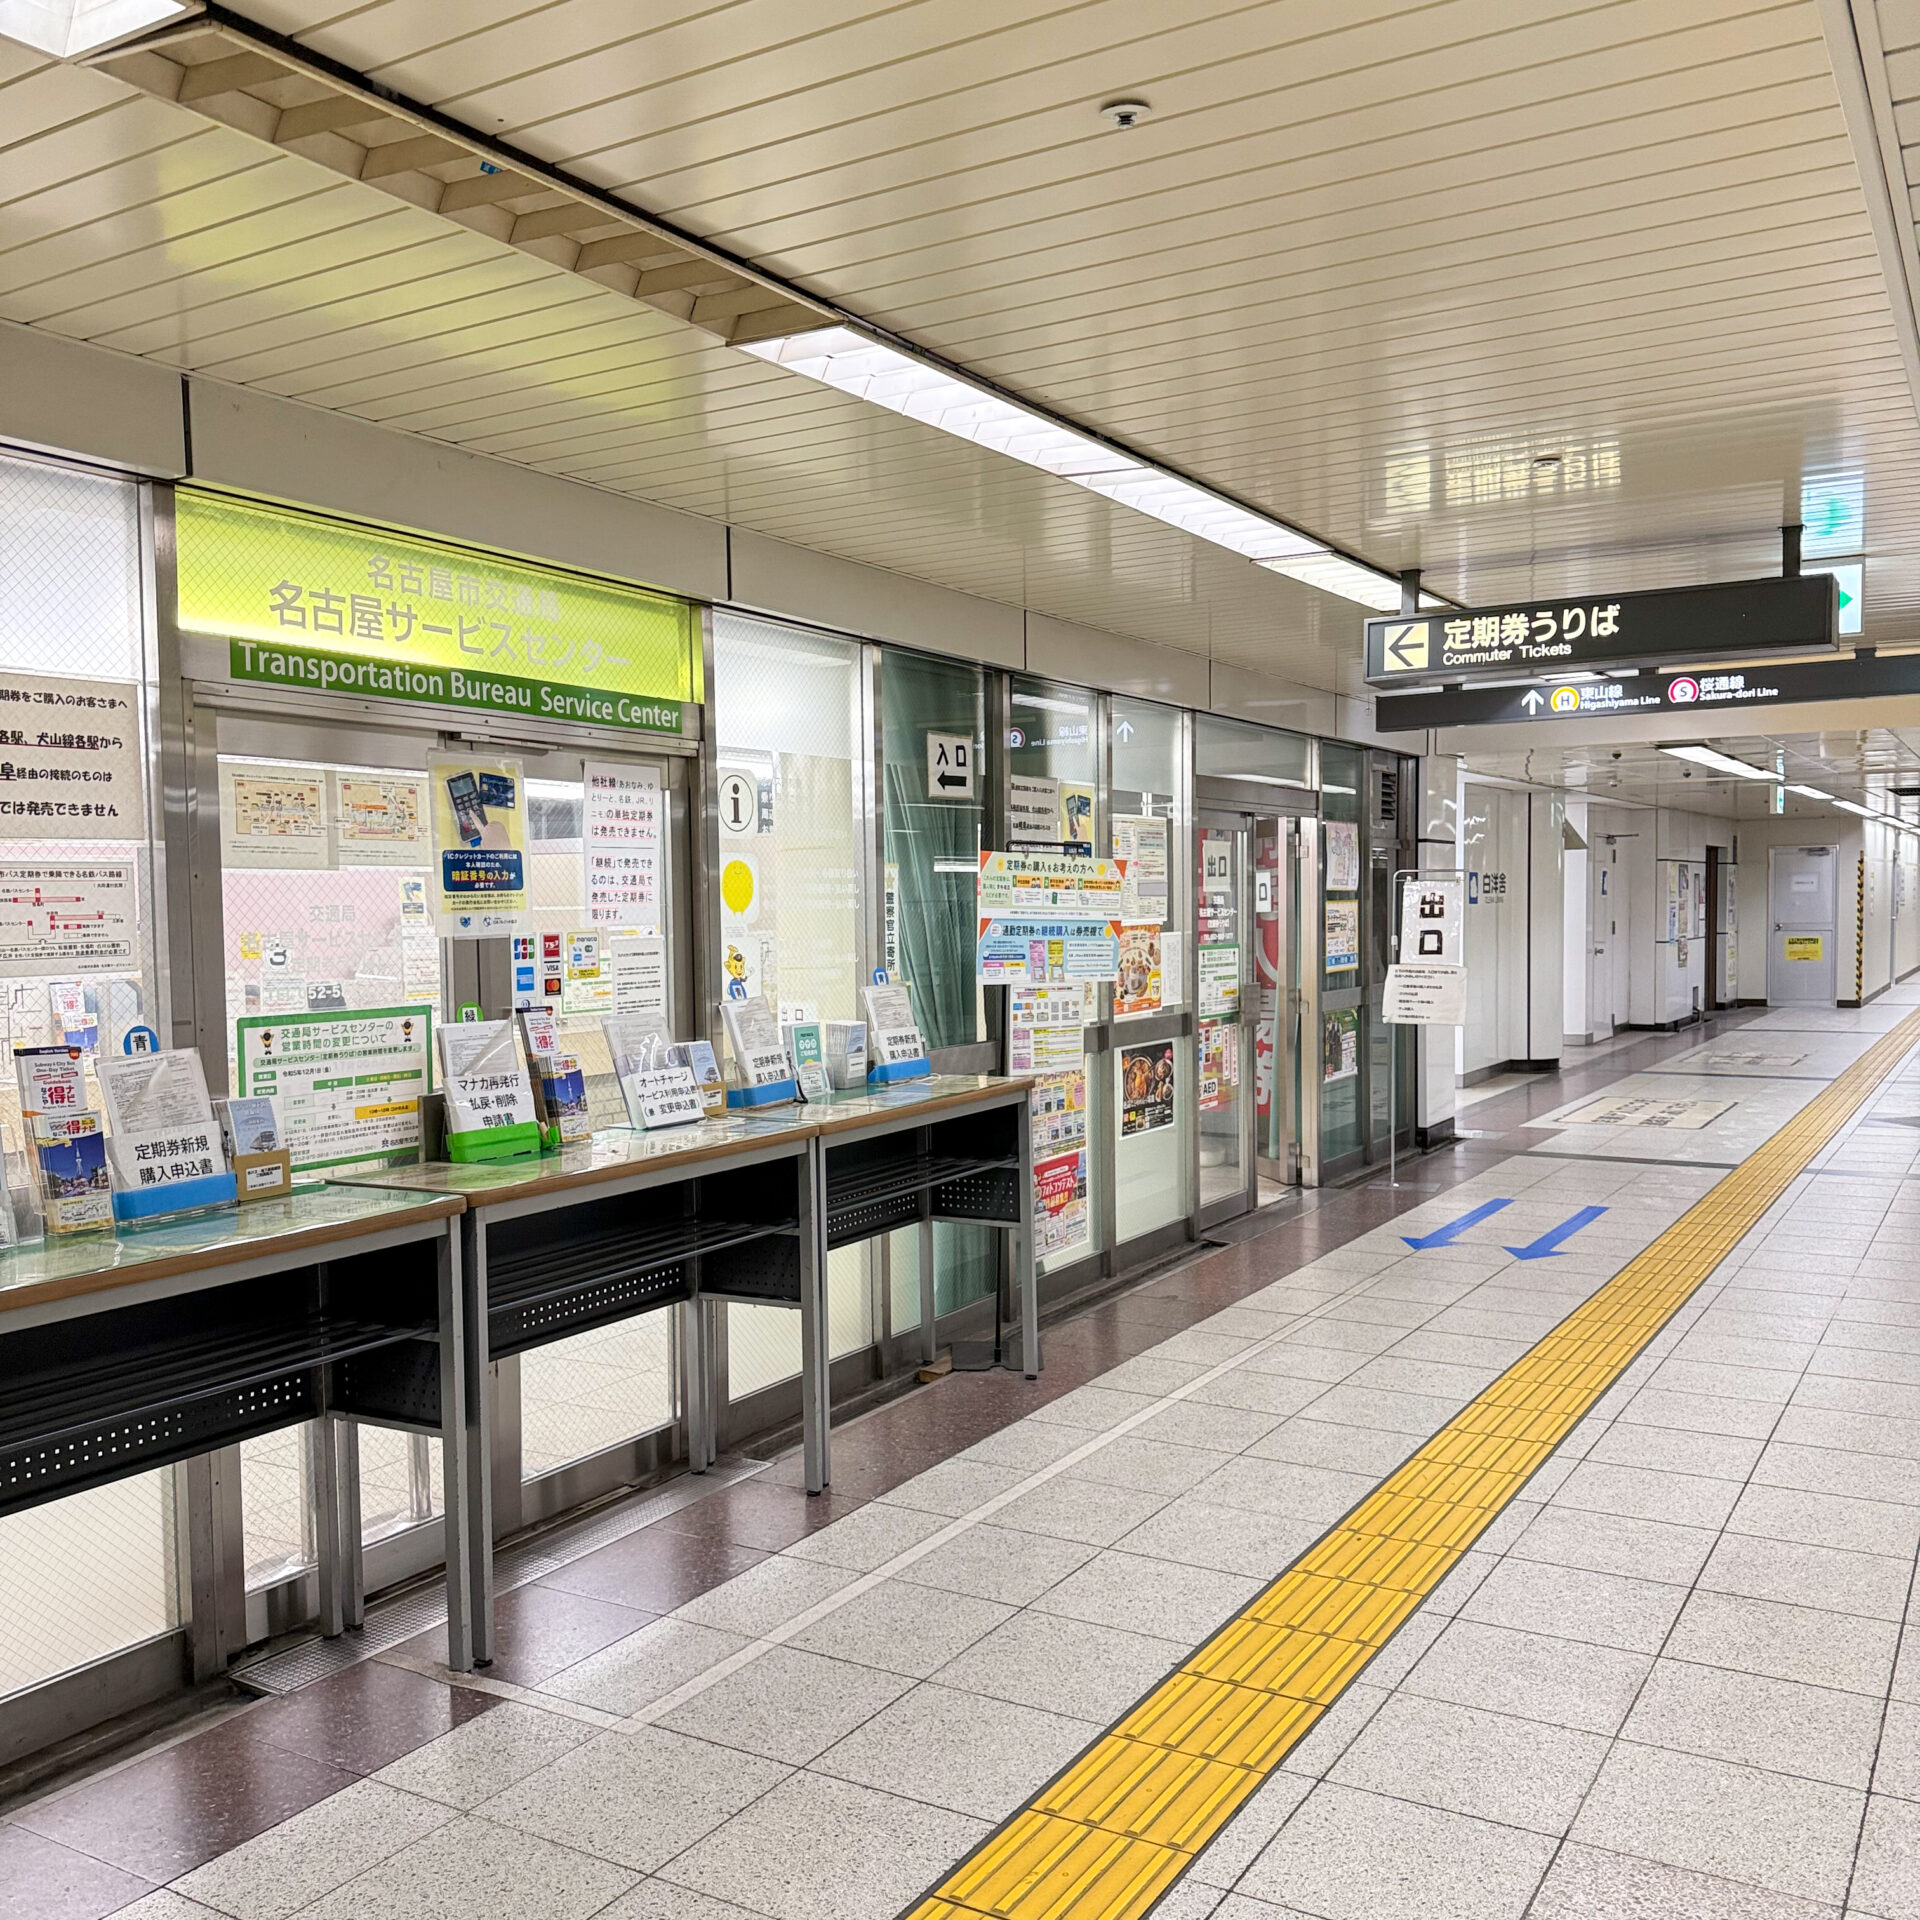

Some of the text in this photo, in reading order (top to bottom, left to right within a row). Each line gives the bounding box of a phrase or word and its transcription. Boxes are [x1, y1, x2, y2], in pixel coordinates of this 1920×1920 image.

[367, 554, 560, 624] 名古屋市交通局
[268, 580, 632, 673] 名古屋サービスセンター
[1443, 604, 1620, 650] 定期券うりば
[1443, 643, 1572, 665] Commuter Tickets
[238, 641, 680, 729] Transportation Bureau Service Center
[1580, 684, 1623, 699] 東山線
[1680, 686, 1687, 697] S
[1700, 675, 1745, 692] 桜通線
[1561, 695, 1570, 705] H
[1699, 686, 1778, 701] Sakura-dori Line
[1580, 695, 1661, 710] Higashiyama Line
[937, 743, 967, 767] 入口
[591, 826, 657, 839] は発売できません。
[1007, 860, 1094, 873] 定期券の購入をお考えの方へ
[1207, 855, 1227, 877] 出口
[591, 874, 653, 885] るのは、交通局で
[591, 892, 653, 903] 発売した定期券に
[1002, 924, 1103, 937] 通勤定期券の継続購入は券売機で
[1419, 892, 1444, 955] 出口
[281, 1021, 393, 1039] 交通局サービスセンターの
[281, 1034, 387, 1052] 営業時間の変更について
[458, 1074, 519, 1091] マナカ再発行
[640, 1071, 688, 1088] オートチャージ
[48, 1086, 66, 1105] 得
[638, 1085, 697, 1102] サービス利用申込書
[1203, 1081, 1216, 1096] AED
[469, 1093, 518, 1110] 払戻・削除
[66, 1120, 80, 1135] 得
[482, 1113, 514, 1127] 申請書
[135, 1135, 209, 1161] 定期券新規
[139, 1158, 213, 1184] 購入申込書
